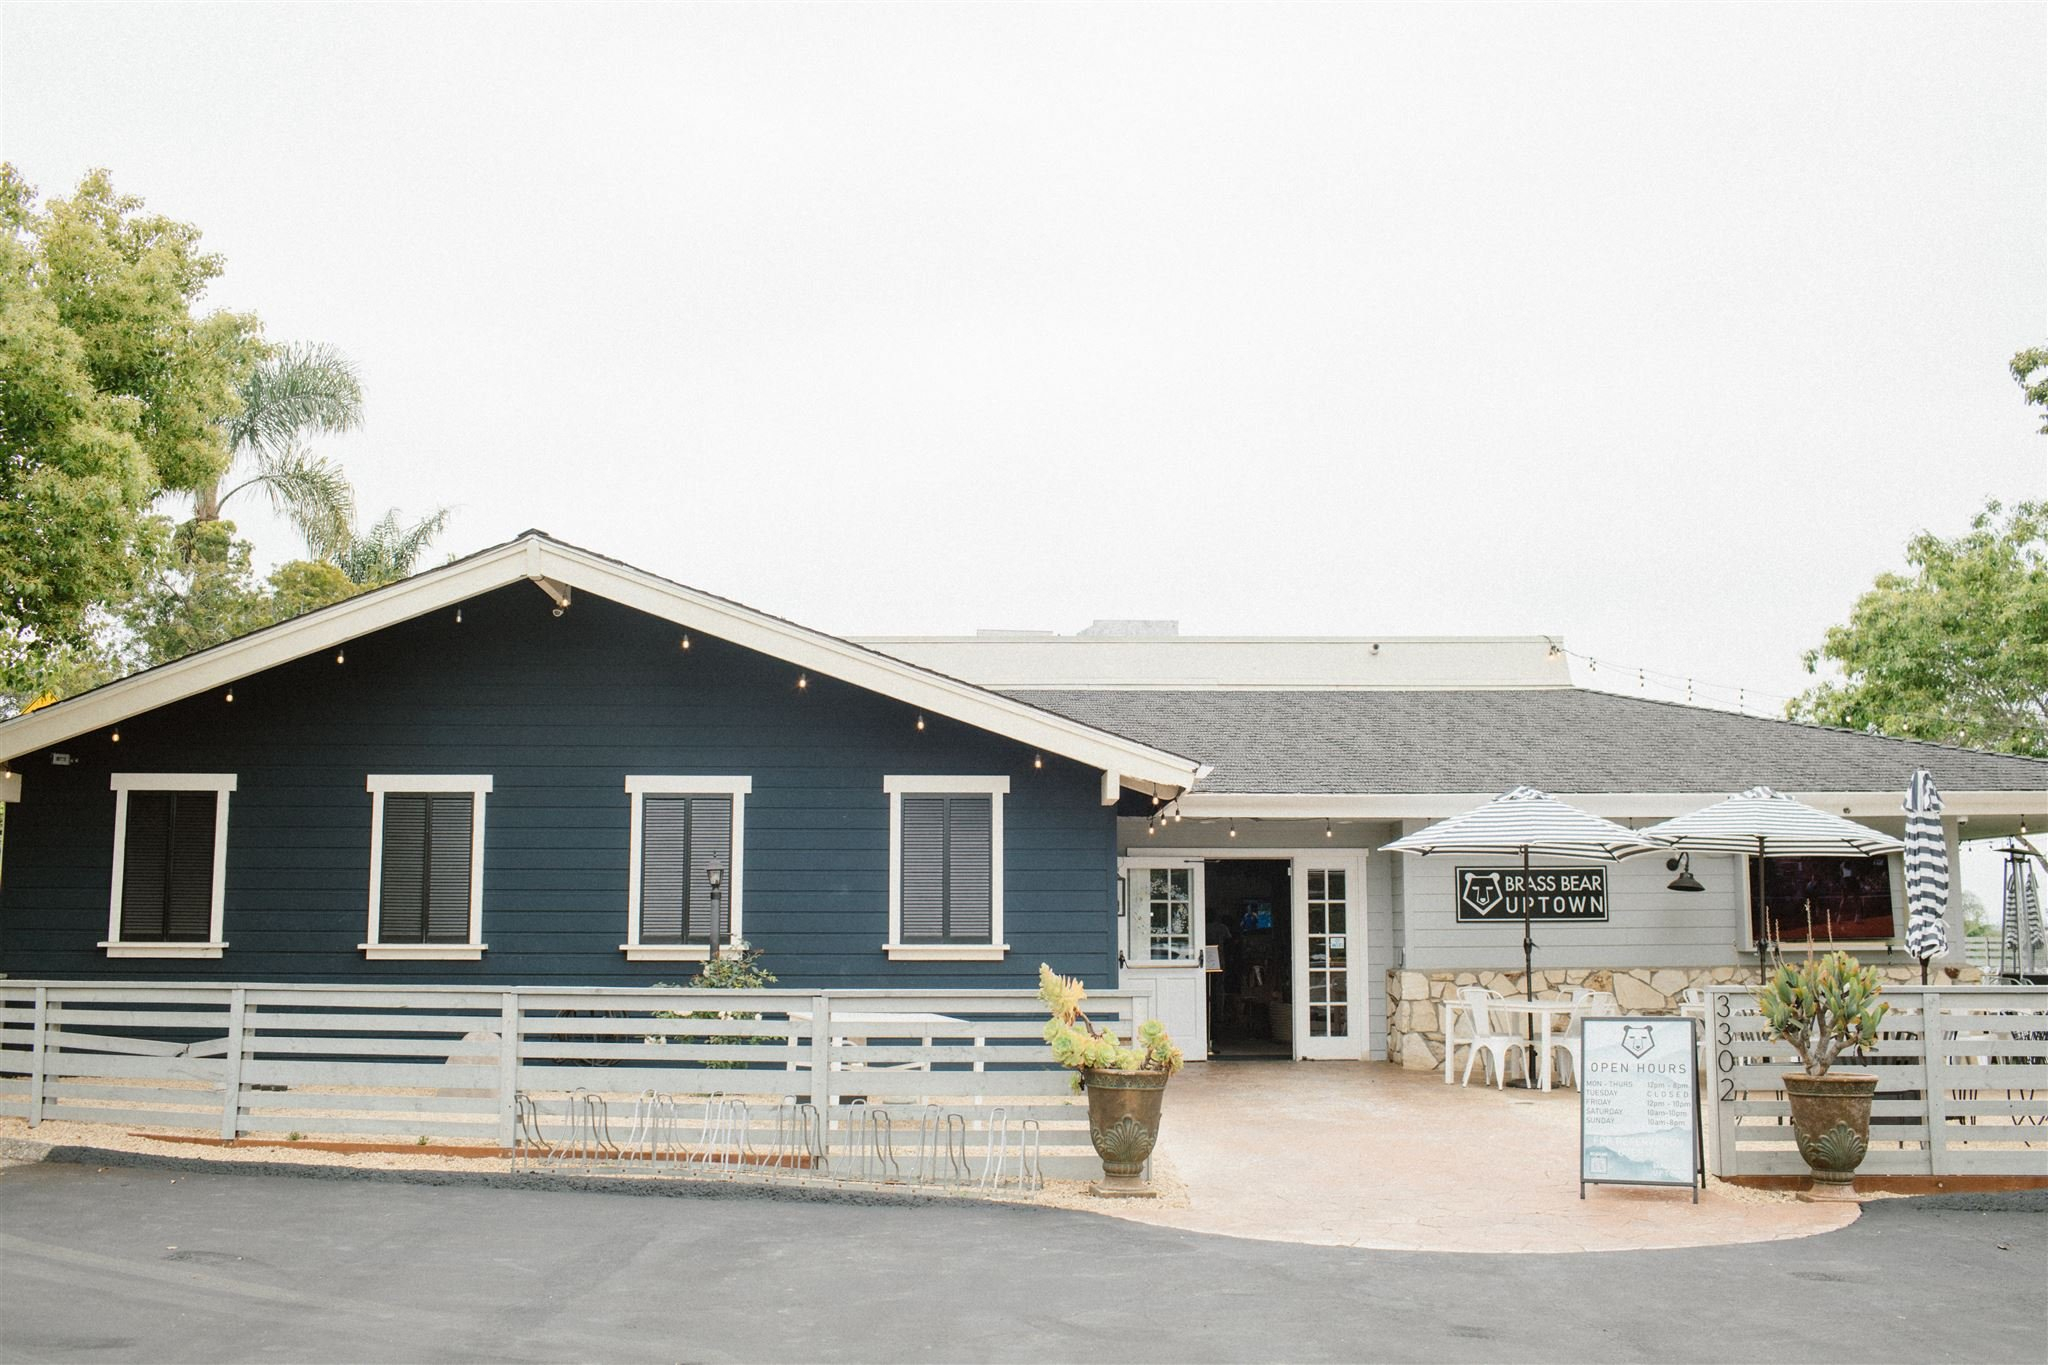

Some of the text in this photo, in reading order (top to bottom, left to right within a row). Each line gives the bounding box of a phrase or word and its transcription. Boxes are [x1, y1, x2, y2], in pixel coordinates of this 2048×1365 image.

[1505, 876, 1602, 892] BRASS BEAR
[1505, 896, 1604, 914] UPTOWN
[1590, 1062, 1687, 1074] OPEN HOURS
[1673, 1082, 1688, 1090] 8pm
[1673, 1100, 1691, 1108] 10pm
